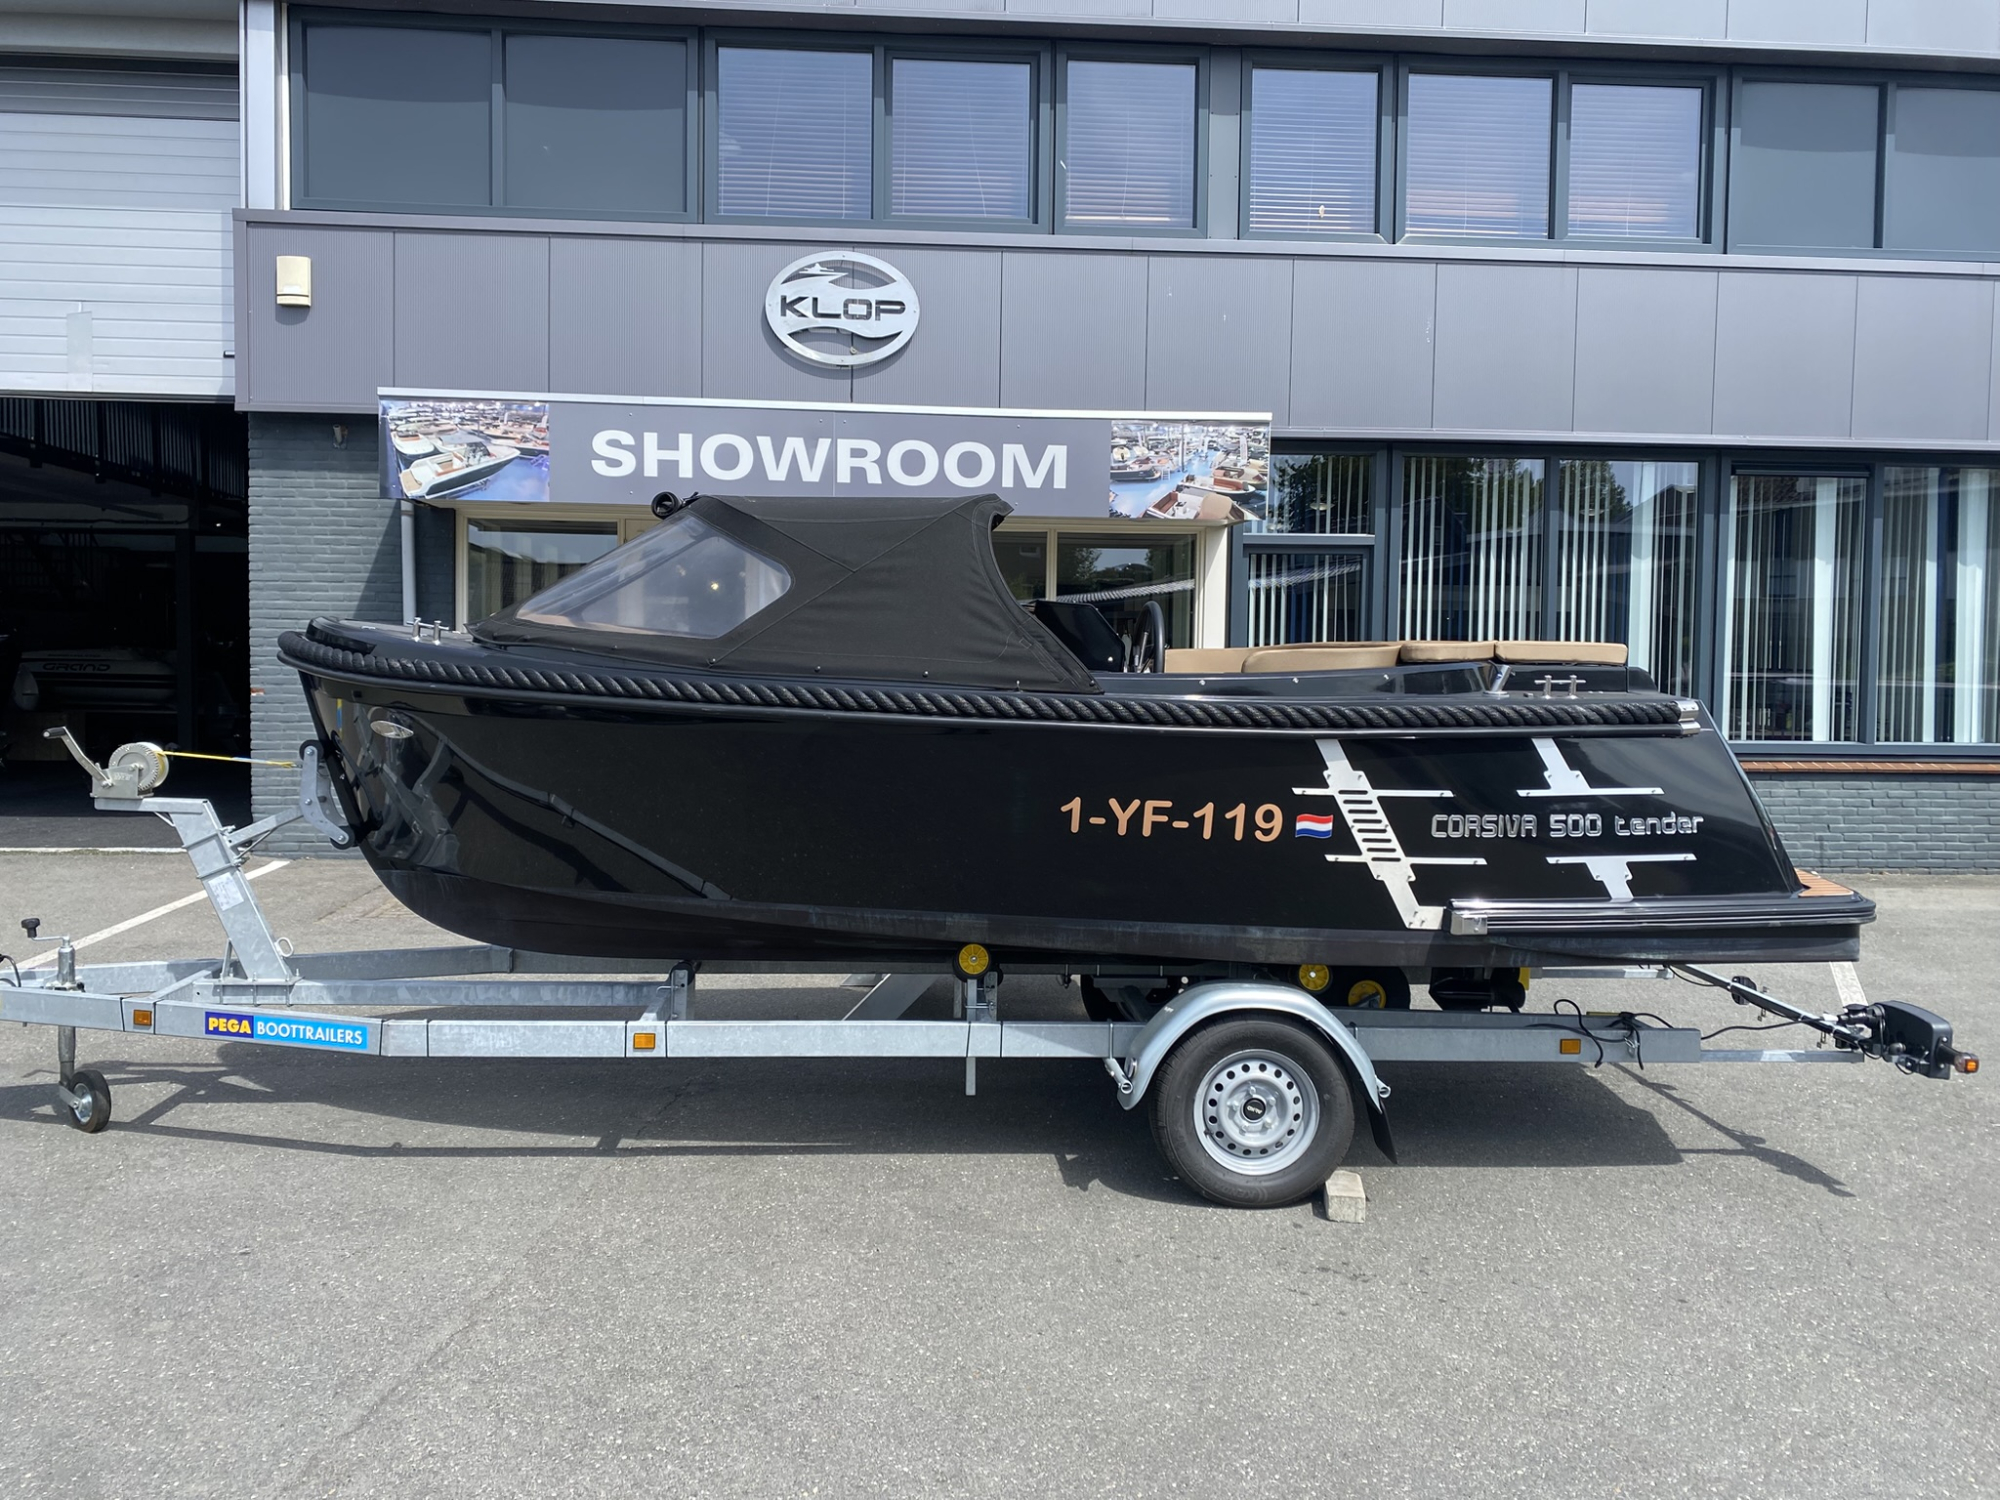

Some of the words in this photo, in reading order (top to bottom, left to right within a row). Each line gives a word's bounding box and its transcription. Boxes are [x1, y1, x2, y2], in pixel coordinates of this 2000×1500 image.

[780, 295, 906, 321] KLOP
[591, 429, 1067, 489] SHOWROOM
[42, 662, 111, 672] GRAND
[1060, 796, 1283, 842] 1-YF-119
[1431, 814, 1537, 838] CORSIVA
[1550, 813, 1602, 837] 500
[1614, 811, 1704, 836] tender
[208, 1017, 251, 1034] PEGA
[257, 1021, 363, 1045] BOOTTRAILERS
